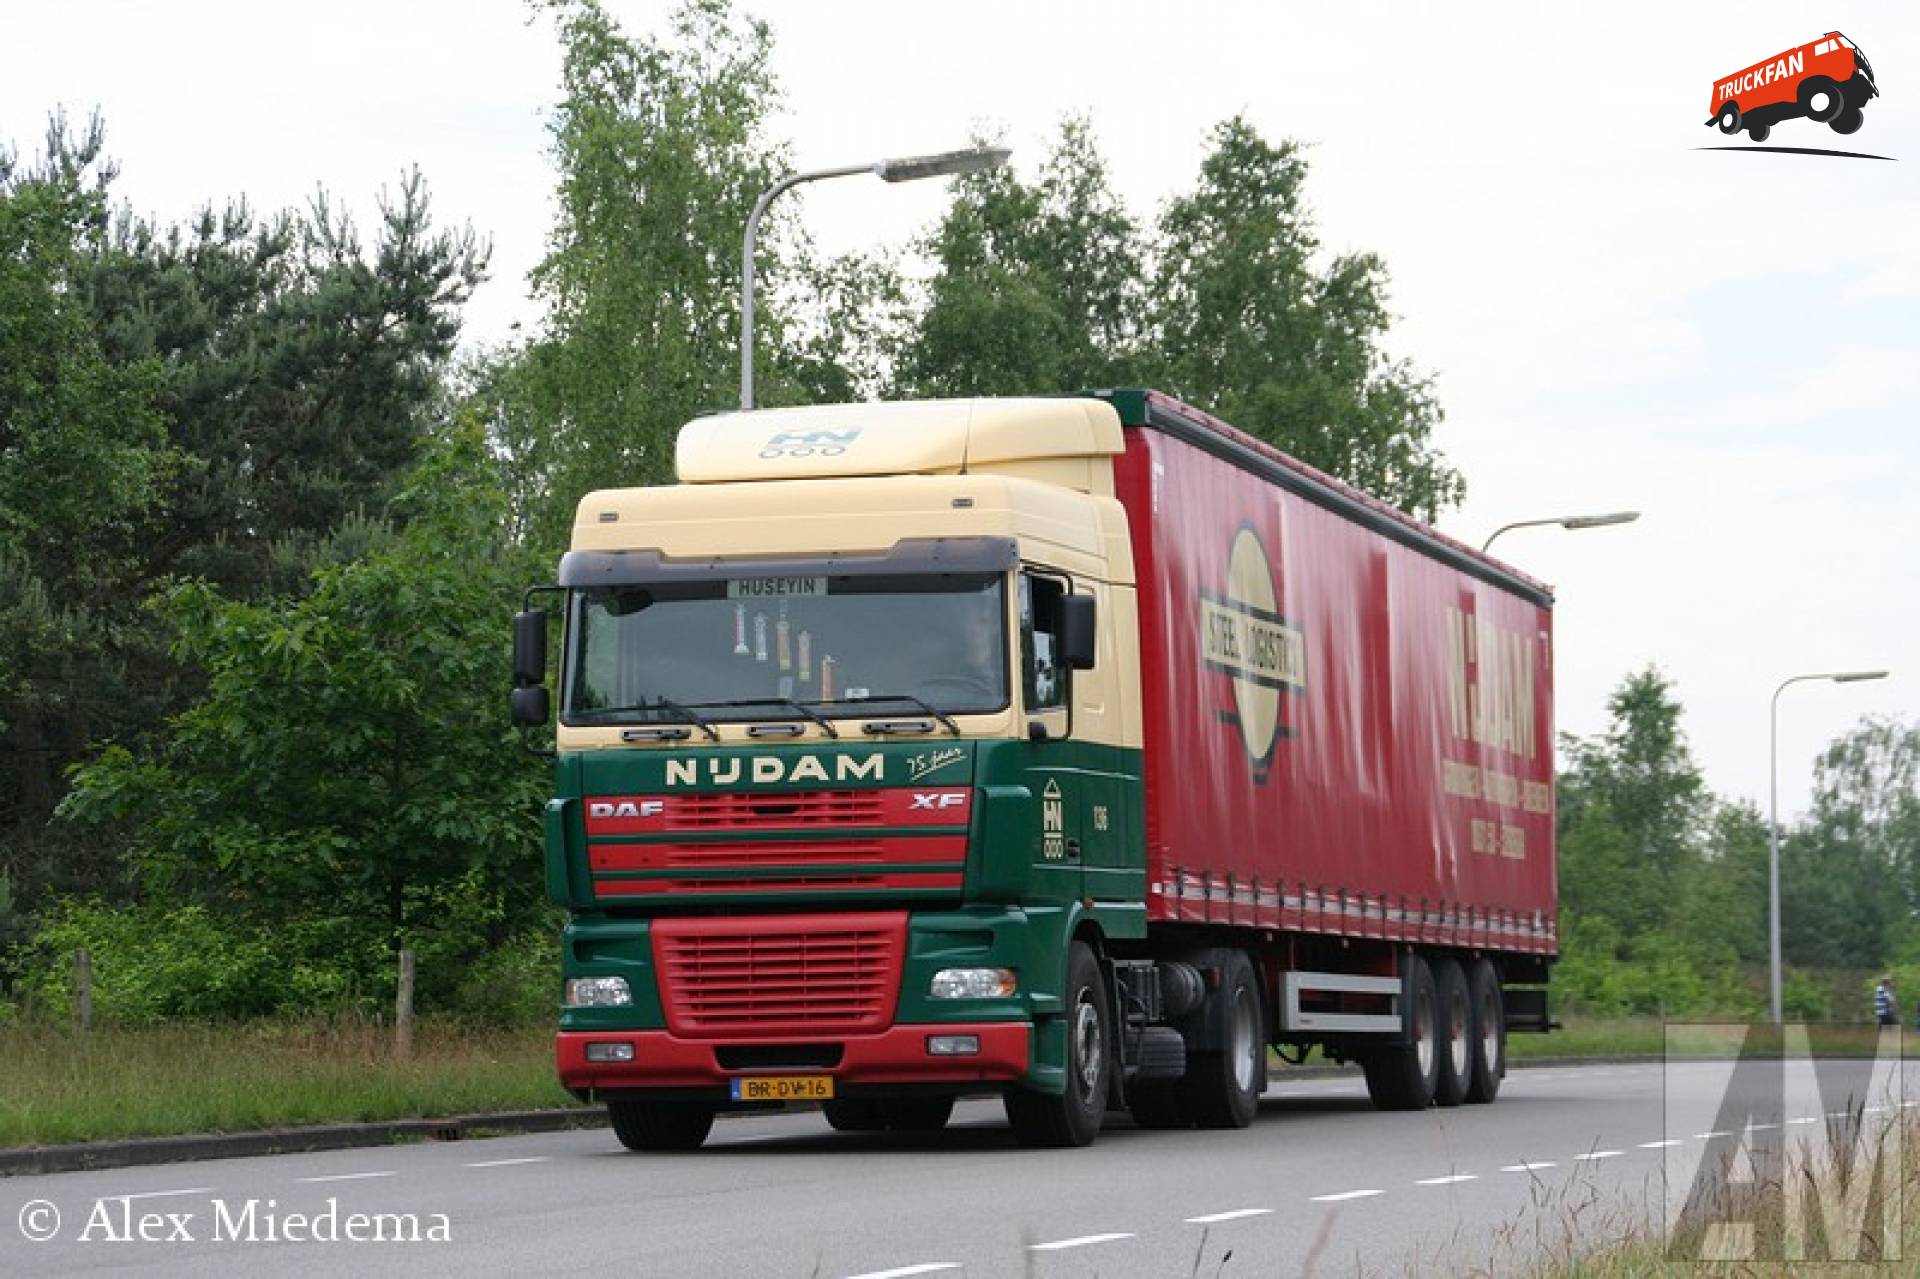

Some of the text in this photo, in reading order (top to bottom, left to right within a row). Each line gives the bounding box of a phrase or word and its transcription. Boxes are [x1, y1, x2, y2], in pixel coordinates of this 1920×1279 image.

[738, 576, 815, 596] HUSEYIN
[589, 801, 664, 818] DAF
[907, 793, 966, 810] XF
